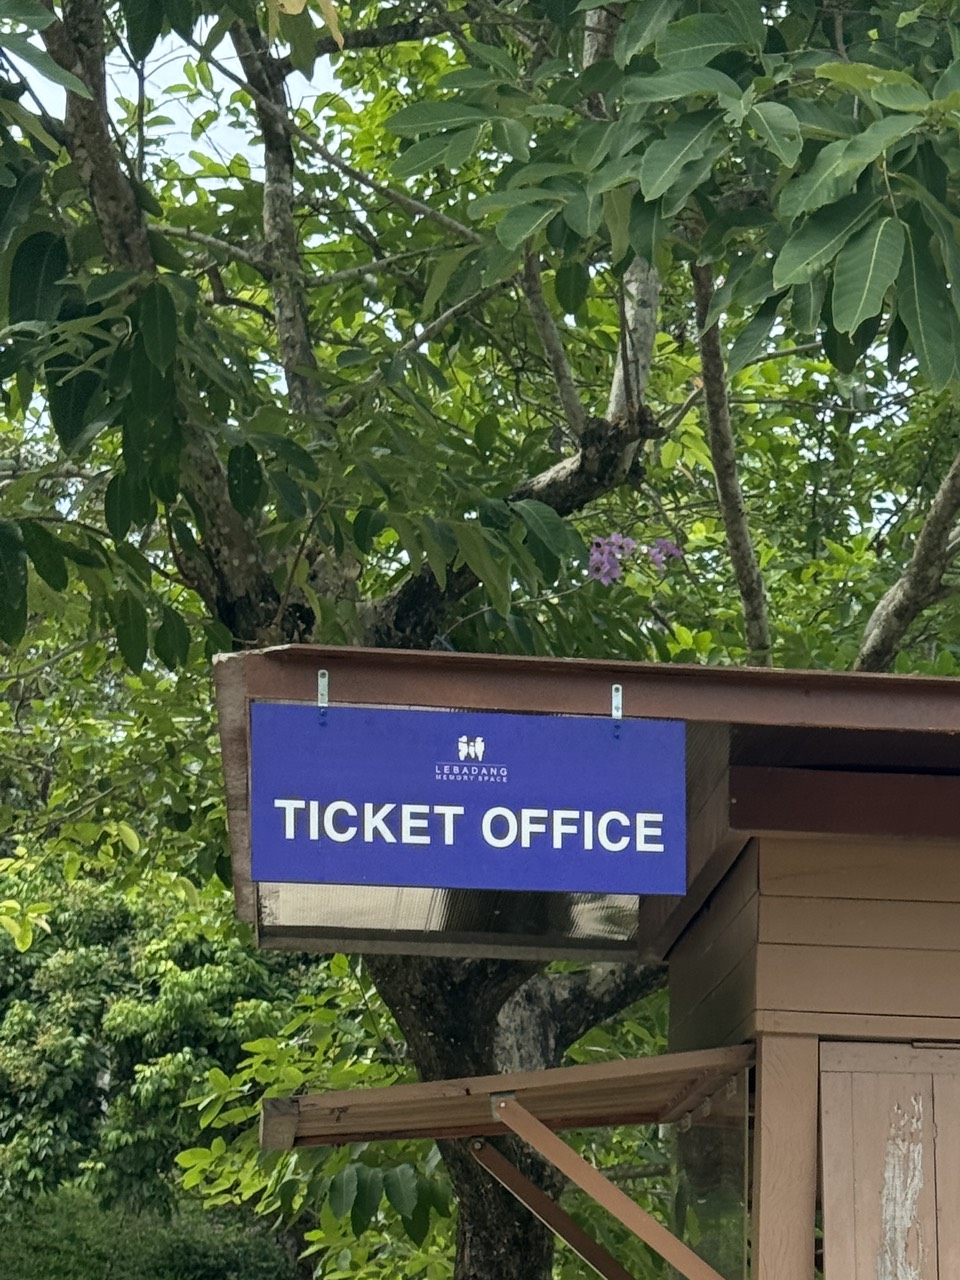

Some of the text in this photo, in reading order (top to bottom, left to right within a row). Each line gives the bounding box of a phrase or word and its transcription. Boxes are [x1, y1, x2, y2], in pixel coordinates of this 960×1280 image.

[435, 765, 508, 776] LEBADANG
[435, 774, 508, 783] MEMORY SPACE
[273, 798, 665, 853] TICKET OFFICE
